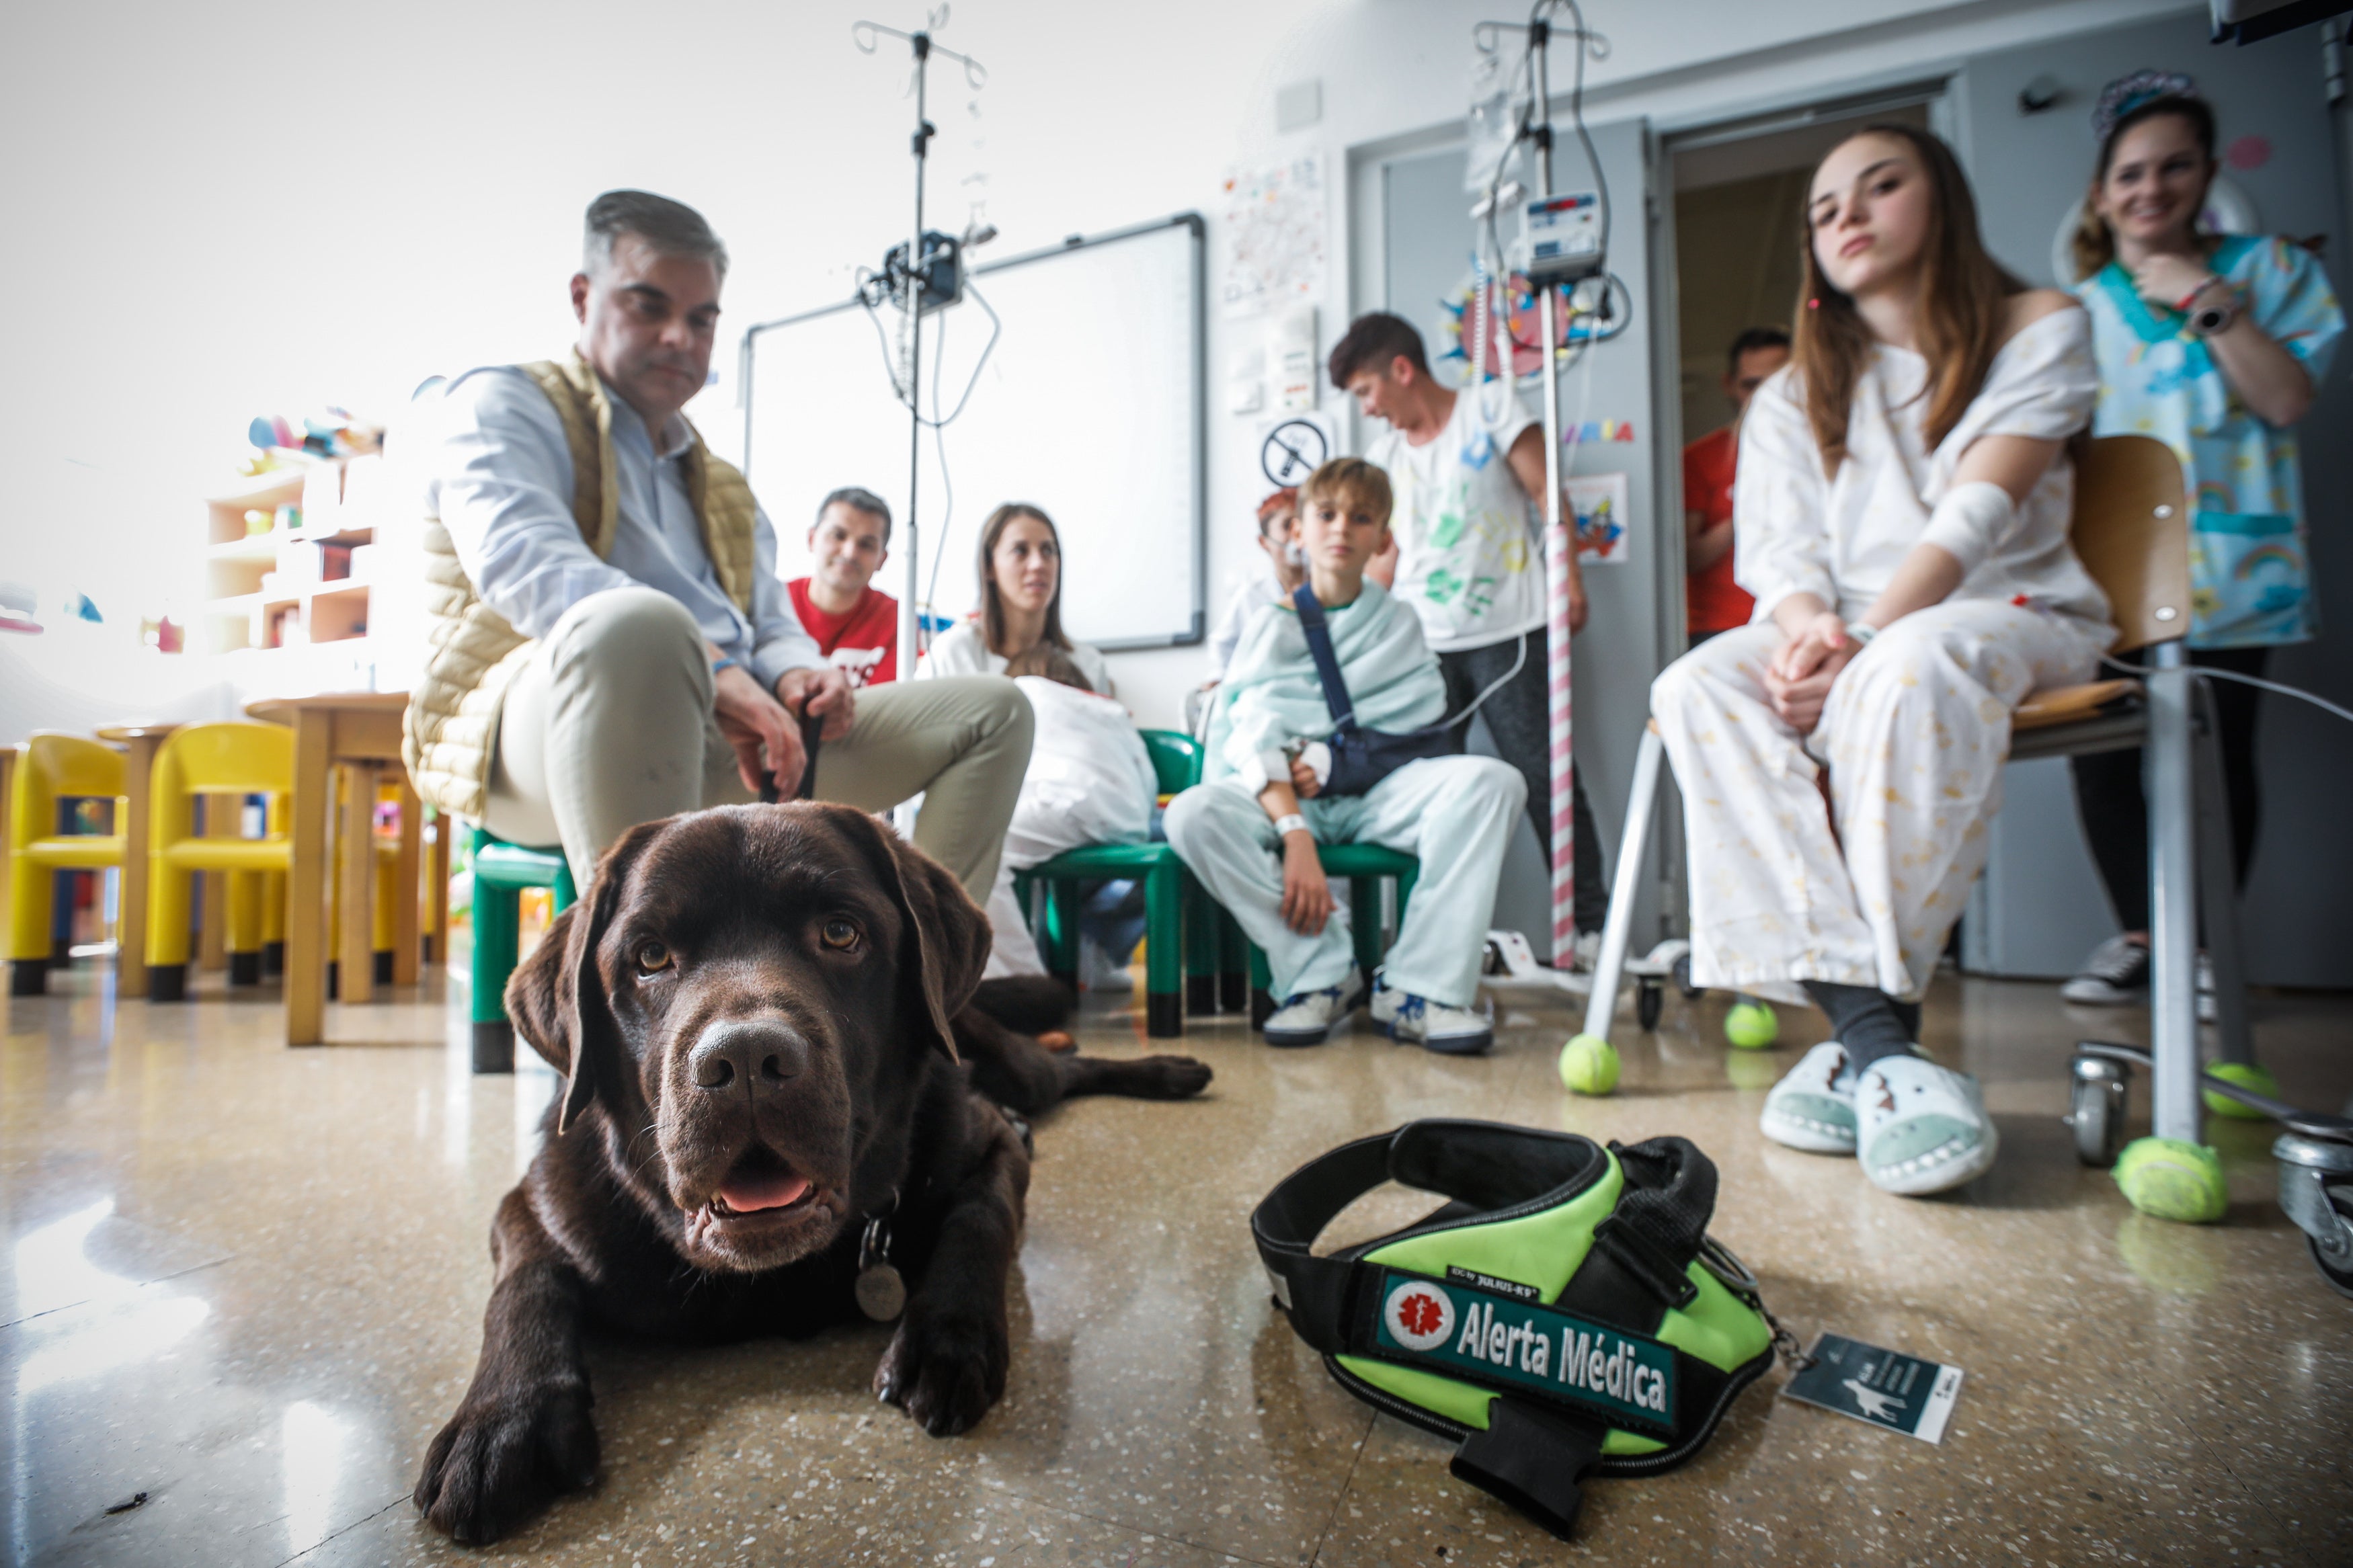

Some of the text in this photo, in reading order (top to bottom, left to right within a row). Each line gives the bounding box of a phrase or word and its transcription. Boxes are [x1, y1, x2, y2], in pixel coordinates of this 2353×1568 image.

[1467, 1271, 1476, 1281] by
[1456, 1301, 1667, 1413] Alerta Médica
